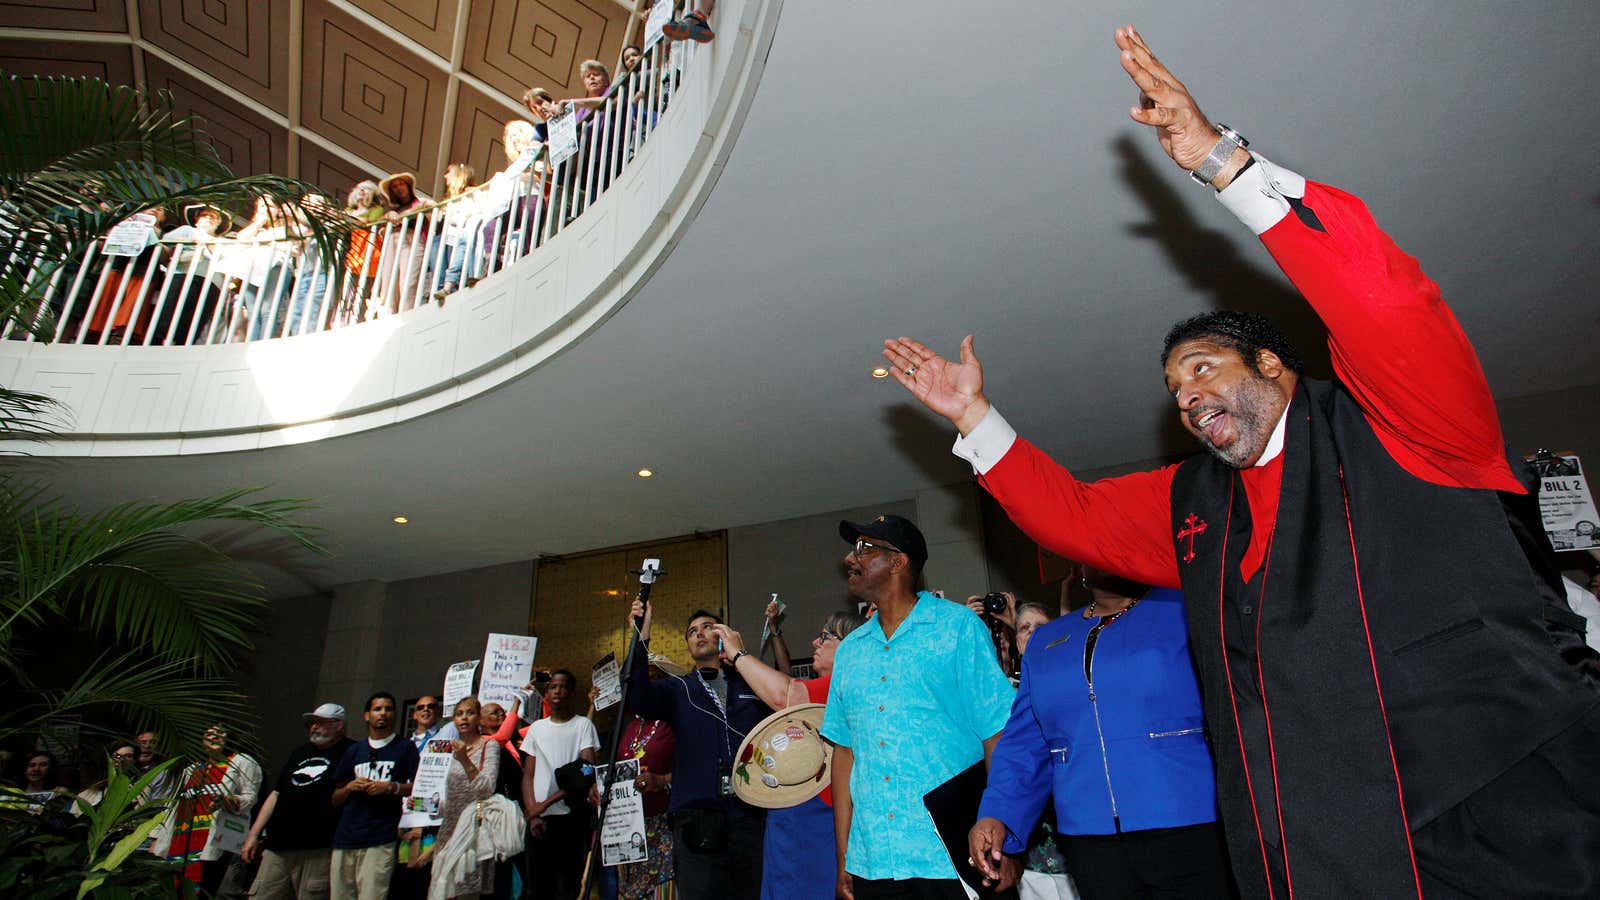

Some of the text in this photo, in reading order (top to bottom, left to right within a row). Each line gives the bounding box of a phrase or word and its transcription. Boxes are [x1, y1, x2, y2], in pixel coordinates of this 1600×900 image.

[1544, 480, 1583, 492] BILL 2
[494, 661, 523, 673] NOT
[616, 787, 630, 799] BILL
